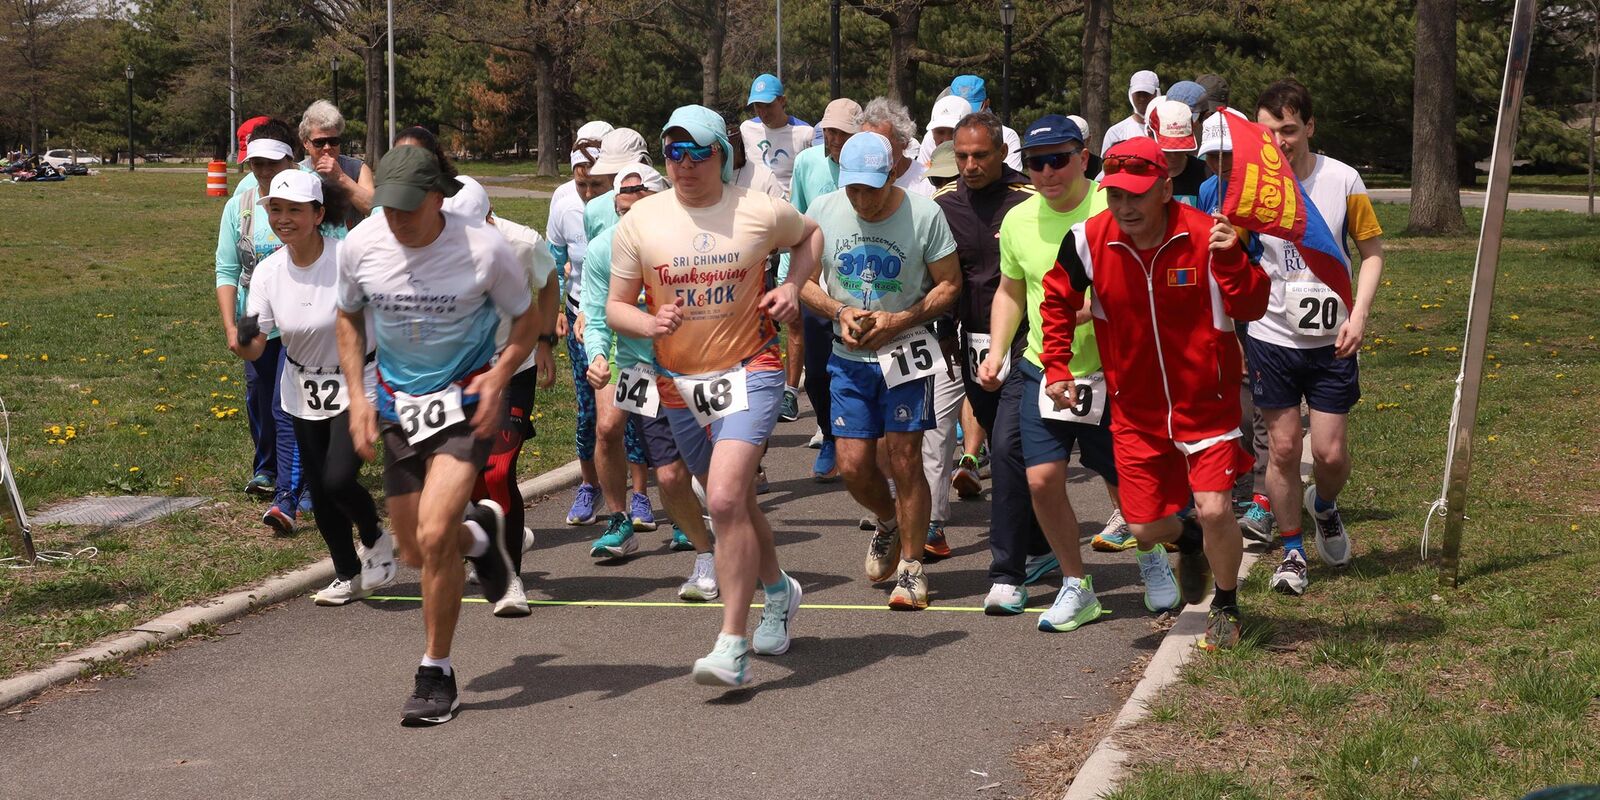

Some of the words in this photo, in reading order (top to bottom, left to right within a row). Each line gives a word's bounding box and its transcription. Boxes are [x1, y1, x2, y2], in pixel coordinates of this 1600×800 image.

[653, 264, 747, 287] Thanksgiving
[673, 256, 690, 267] SRI
[693, 252, 740, 266] CHINMOY
[837, 252, 902, 278] 3100
[874, 282, 897, 290] Race
[1298, 297, 1338, 329] 20
[891, 339, 933, 377] 15
[303, 379, 341, 411] 32
[615, 371, 649, 408] 54
[693, 378, 733, 417] 48
[400, 399, 446, 438] 30
